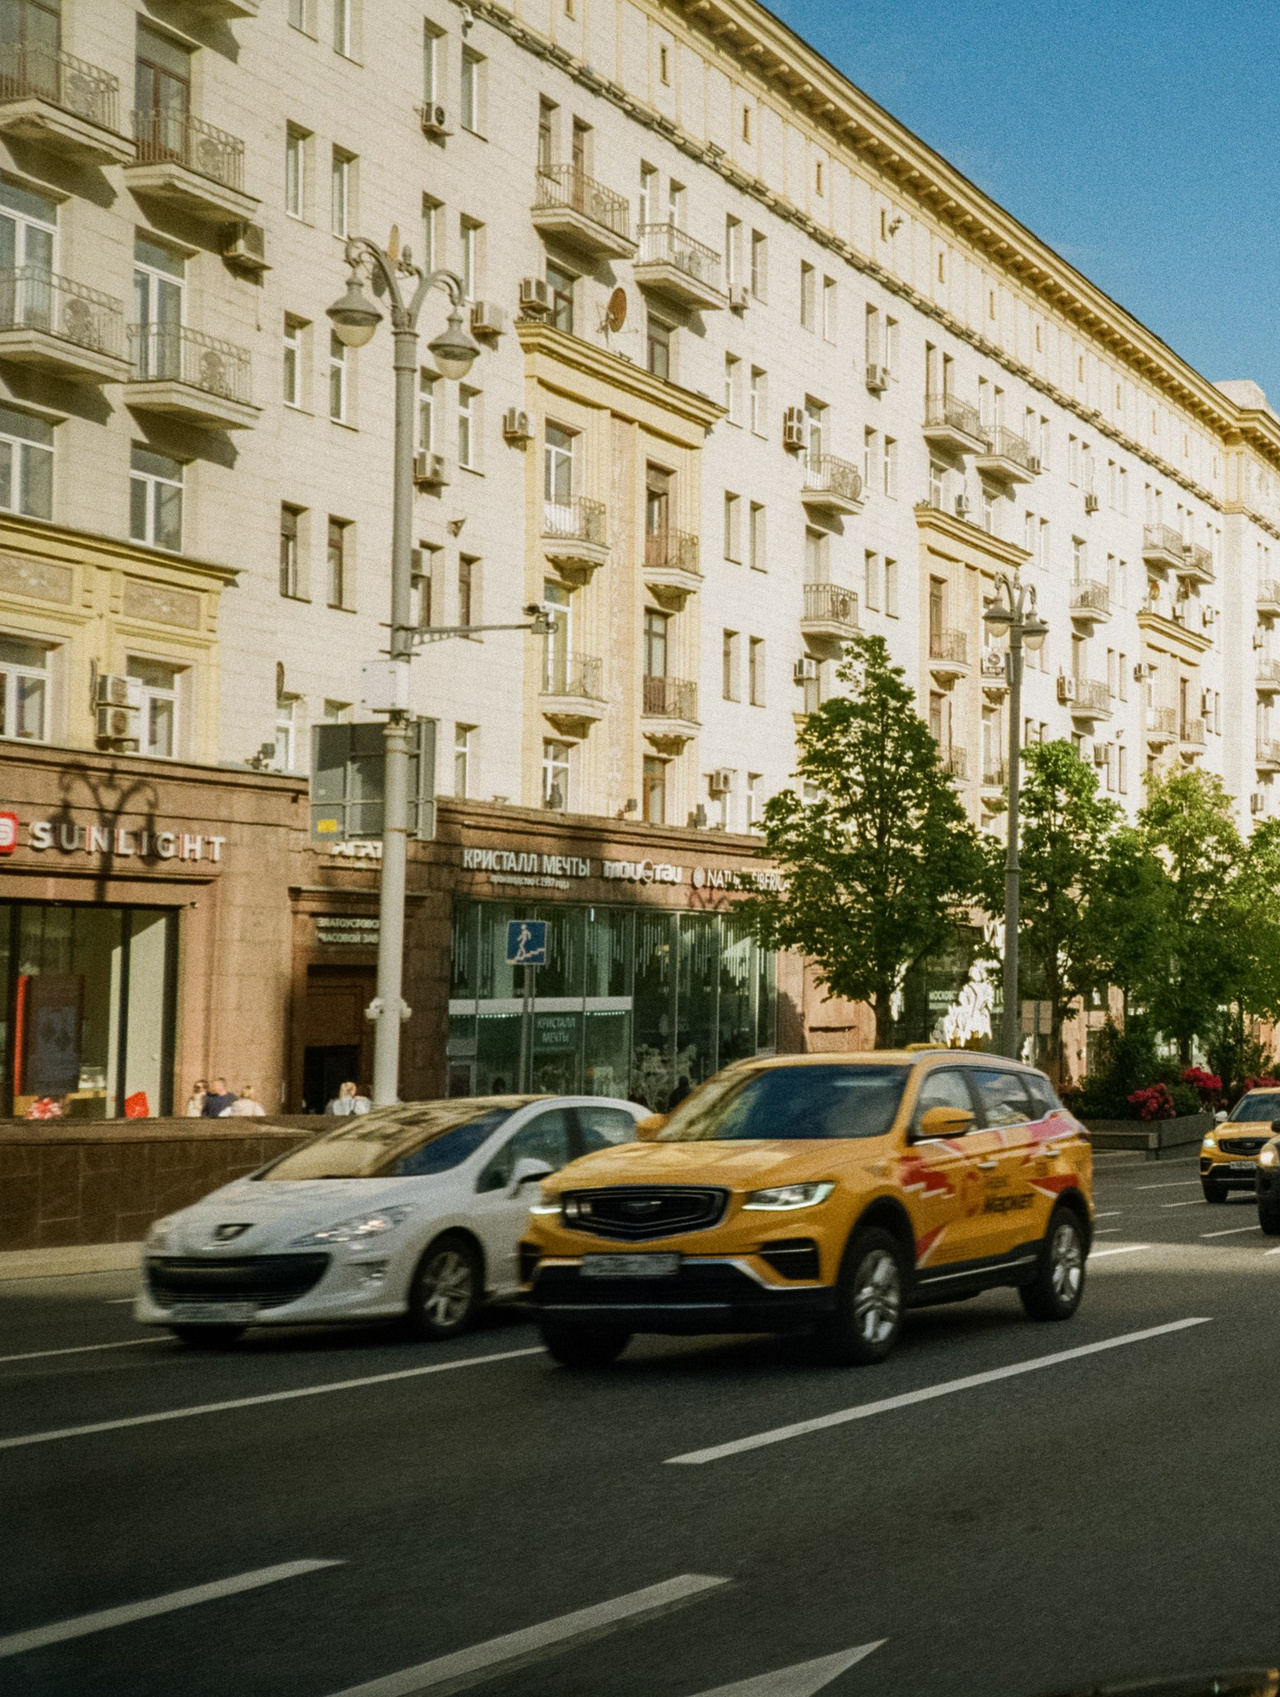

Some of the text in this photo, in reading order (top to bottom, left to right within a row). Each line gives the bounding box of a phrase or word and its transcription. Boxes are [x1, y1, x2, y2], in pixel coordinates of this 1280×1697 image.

[29, 820, 227, 862] SUNLIGHT
[463, 848, 590, 877] КРИСТАЛЛ МЕЧТЫ
[707, 868, 747, 889] NATR
